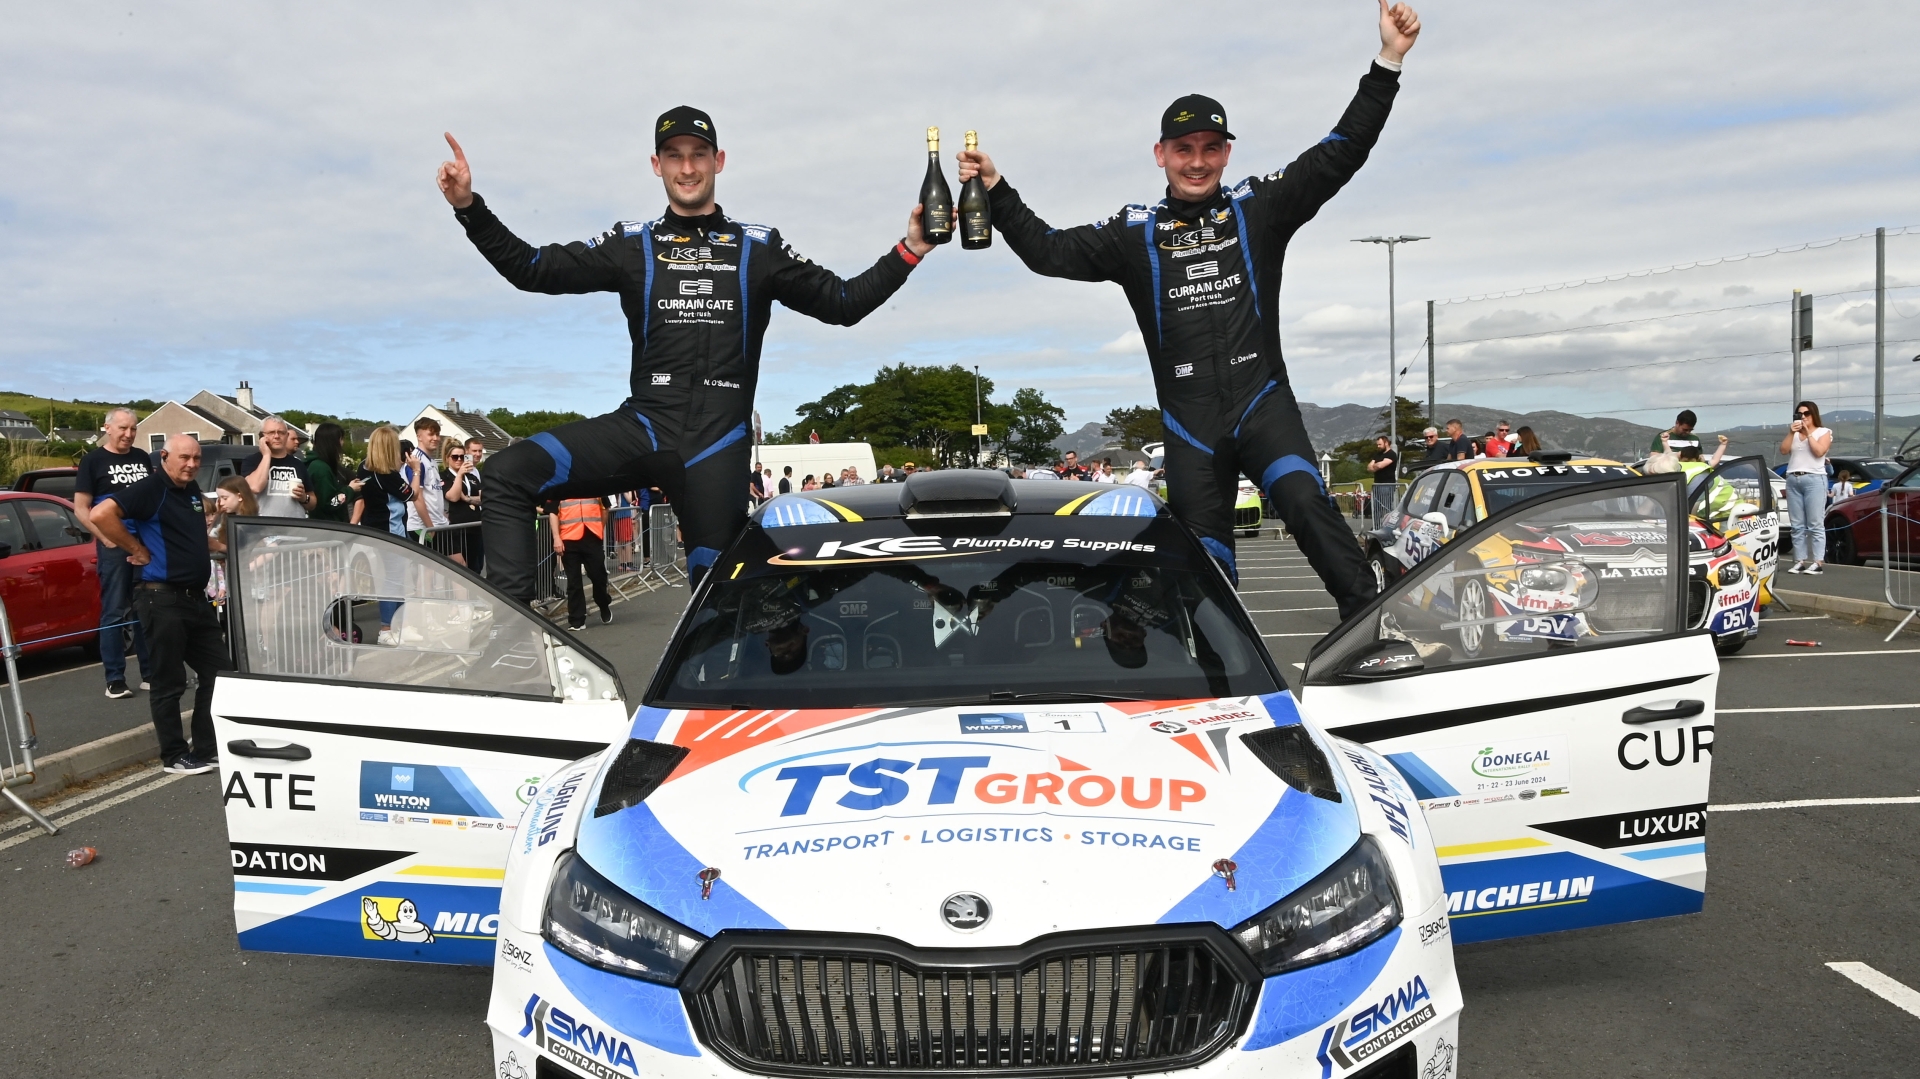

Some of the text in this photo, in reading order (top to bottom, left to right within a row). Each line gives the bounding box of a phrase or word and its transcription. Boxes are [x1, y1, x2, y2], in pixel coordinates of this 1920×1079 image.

[1128, 212, 1149, 220] OMP
[624, 224, 644, 232] OMP
[745, 228, 767, 239] OMP
[1207, 237, 1239, 252] Supplies
[704, 262, 737, 272] Supplies
[1168, 273, 1242, 299] CURRAN GATE
[657, 298, 735, 311] CURRAN GATE
[1177, 304, 1196, 312] Luxury
[1237, 351, 1258, 363] Devine
[1175, 365, 1194, 377] OMP
[651, 375, 672, 384] OMP
[711, 379, 740, 389] O'Sullivan
[107, 463, 148, 475] JACK&
[271, 469, 295, 481] JACK&
[1482, 465, 1629, 481] MOFFETT
[1746, 516, 1778, 531] Keltech
[815, 535, 947, 559] KE
[951, 536, 1157, 553] Plumbing Supplies
[730, 562, 744, 579] 1
[1600, 568, 1624, 579] LA
[979, 581, 998, 590] OMP
[1046, 576, 1076, 587] OMP
[912, 599, 932, 608] OMP
[1516, 595, 1574, 611] ifm.ie
[1718, 589, 1750, 607] ifm.ie
[762, 603, 781, 611] OMP
[839, 603, 869, 615] OMP
[1523, 616, 1568, 635] DSV
[1723, 607, 1747, 630] DSV
[1054, 720, 1071, 731] 1
[1187, 711, 1256, 726] SAMDEC
[965, 724, 1024, 732] WILTON
[1617, 725, 1715, 771] CUR
[1481, 749, 1551, 768] DONEGAL
[1482, 765, 1517, 774] INTERNATIONAL
[223, 769, 317, 812] ATE
[775, 755, 1208, 818] TST GROUP
[1477, 783, 1485, 791] 21
[1490, 781, 1499, 789] 22
[1505, 780, 1513, 788] 23
[1514, 778, 1530, 787] June
[1531, 776, 1547, 785] 2024
[374, 793, 431, 807] WILTON
[376, 803, 429, 811] RECYCLING
[920, 827, 1054, 844] LOGISTICS
[1080, 830, 1202, 852] STORAGE
[743, 830, 896, 861] TRANSPORT
[231, 851, 327, 874] DATION
[1444, 876, 1595, 914] MICHELIN
[431, 911, 498, 935] MIC
[1343, 974, 1431, 1049] SKWA
[1357, 1006, 1432, 1059] CONTRACTING
[545, 1006, 640, 1077] SKWA
